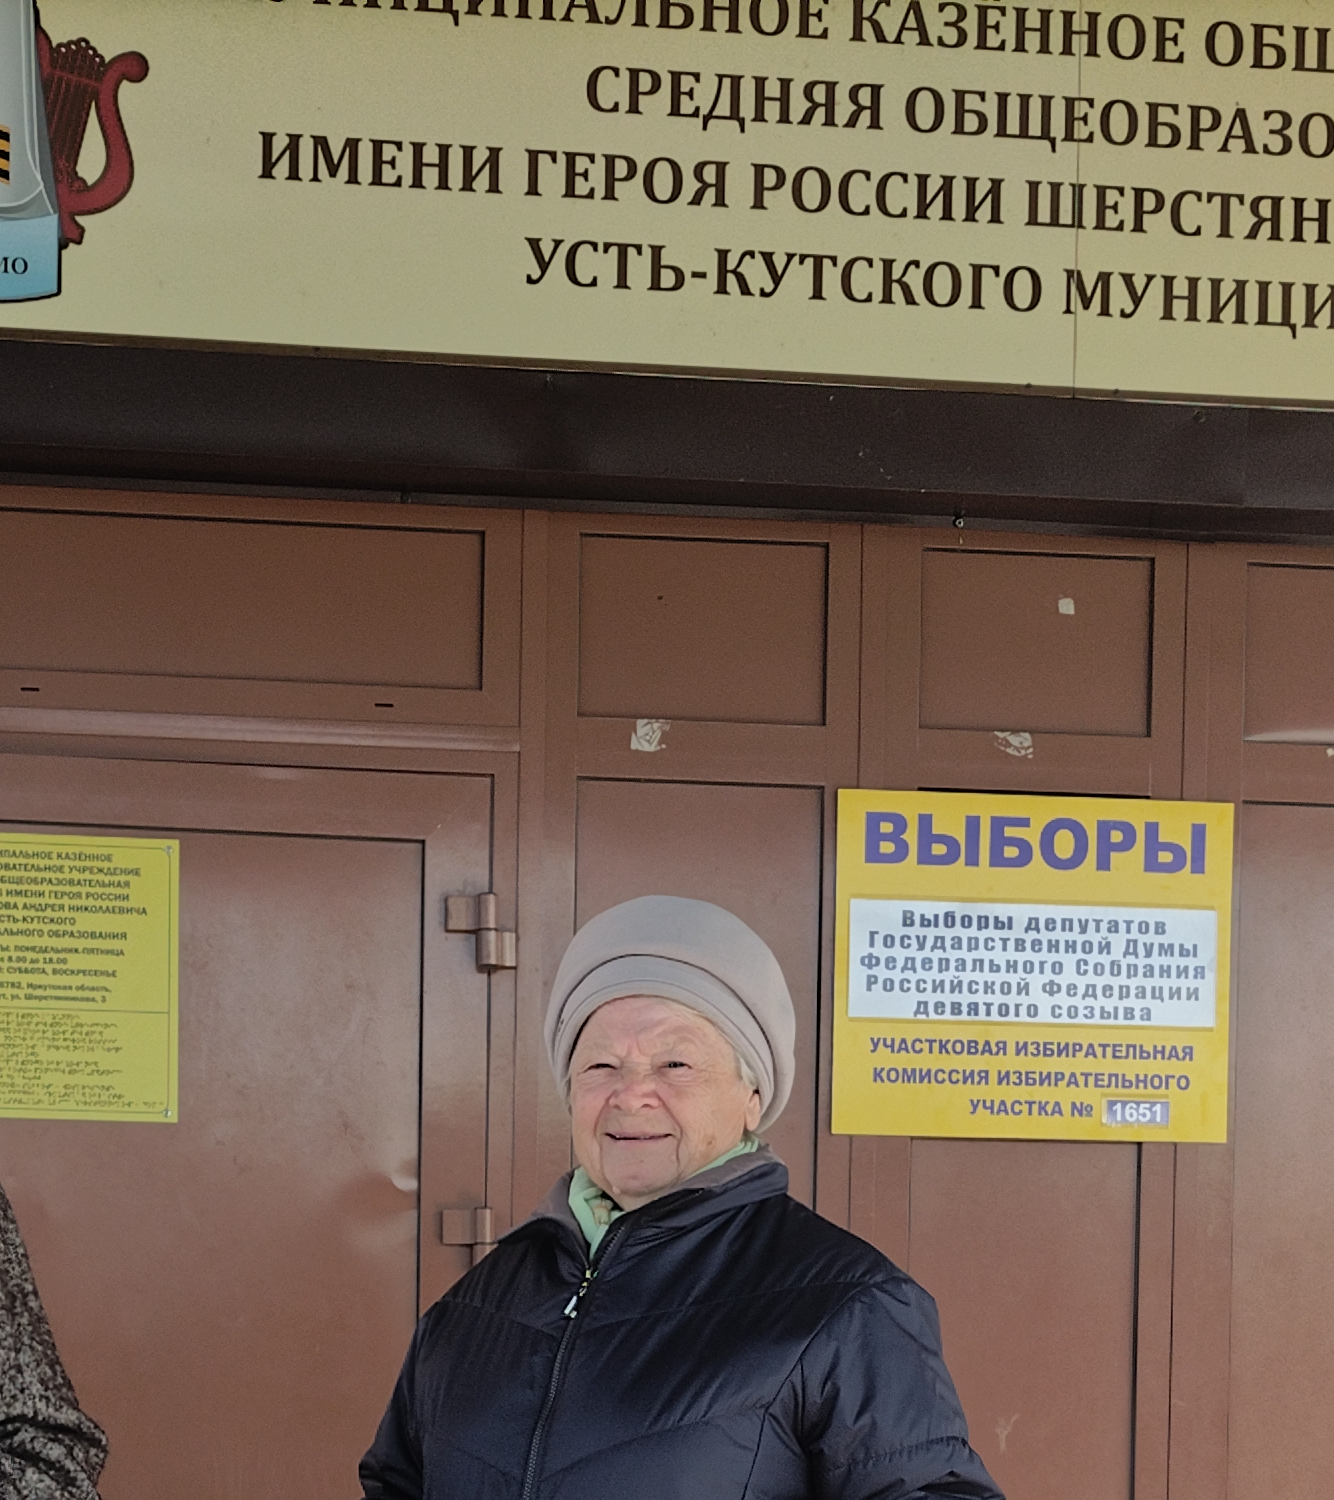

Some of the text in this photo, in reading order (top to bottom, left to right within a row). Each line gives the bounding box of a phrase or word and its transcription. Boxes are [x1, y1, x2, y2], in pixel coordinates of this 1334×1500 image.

[586, 66, 885, 133] СРЕДНЯЯ
[257, 132, 504, 195] ИМЕНИ
[523, 149, 730, 209] ГЕРОЯ
[749, 163, 1005, 225] РОССИИ
[523, 237, 1043, 313] УСТЬ-КУТСКОГО
[864, 811, 1207, 875] ВЫБОРЫ
[68, 864, 142, 877] УЧРЕЖДЕНИЕ
[5, 888, 46, 899] ИМЕНИ
[48, 890, 83, 901] ГЕРОЯ
[85, 891, 130, 903] РОССИИ
[21, 901, 66, 913] АНДРЕЯ
[68, 903, 148, 916] НИКОЛАЕВИЧА
[46, 928, 128, 941] ОБРАЗОВАНИЯ
[901, 909, 1167, 936] Выборы депутатов
[868, 930, 1198, 959] Государственной Думы
[859, 953, 1206, 981] Федерального Собрания
[865, 973, 1200, 1002] Российской Федерации
[913, 1000, 1153, 1022] девятого созыва
[869, 1036, 1194, 1062] УЧАСТКОВАЯ ИЗБИРАТЕЛЬНАЯ
[872, 1066, 1191, 1091] КОМИССИЯ ИЗБИРАТЕЛЬНОГО
[969, 1098, 1162, 1123] УЧАСТКА № 1651
